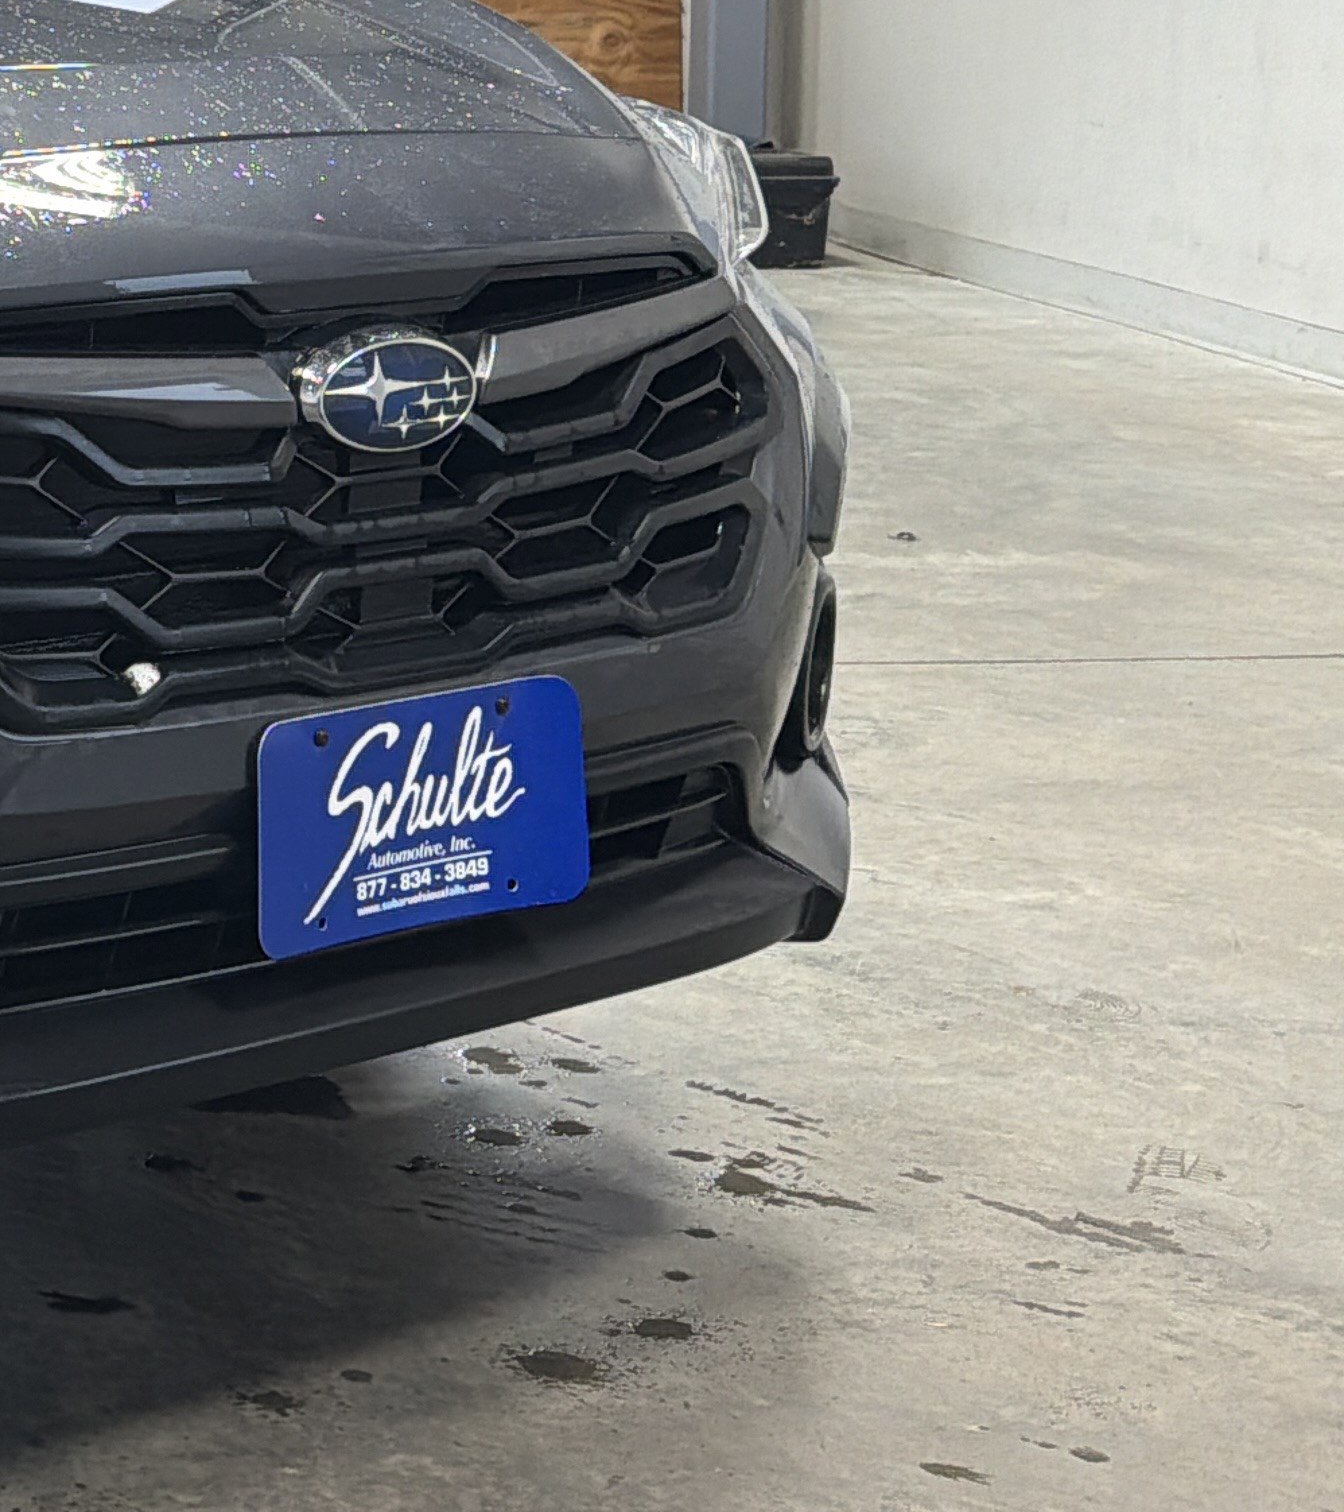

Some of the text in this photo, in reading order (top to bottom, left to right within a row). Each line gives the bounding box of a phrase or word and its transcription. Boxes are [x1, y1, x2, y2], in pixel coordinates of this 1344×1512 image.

[303, 705, 526, 925] Schulte
[366, 835, 476, 870] Automotive, Inc.
